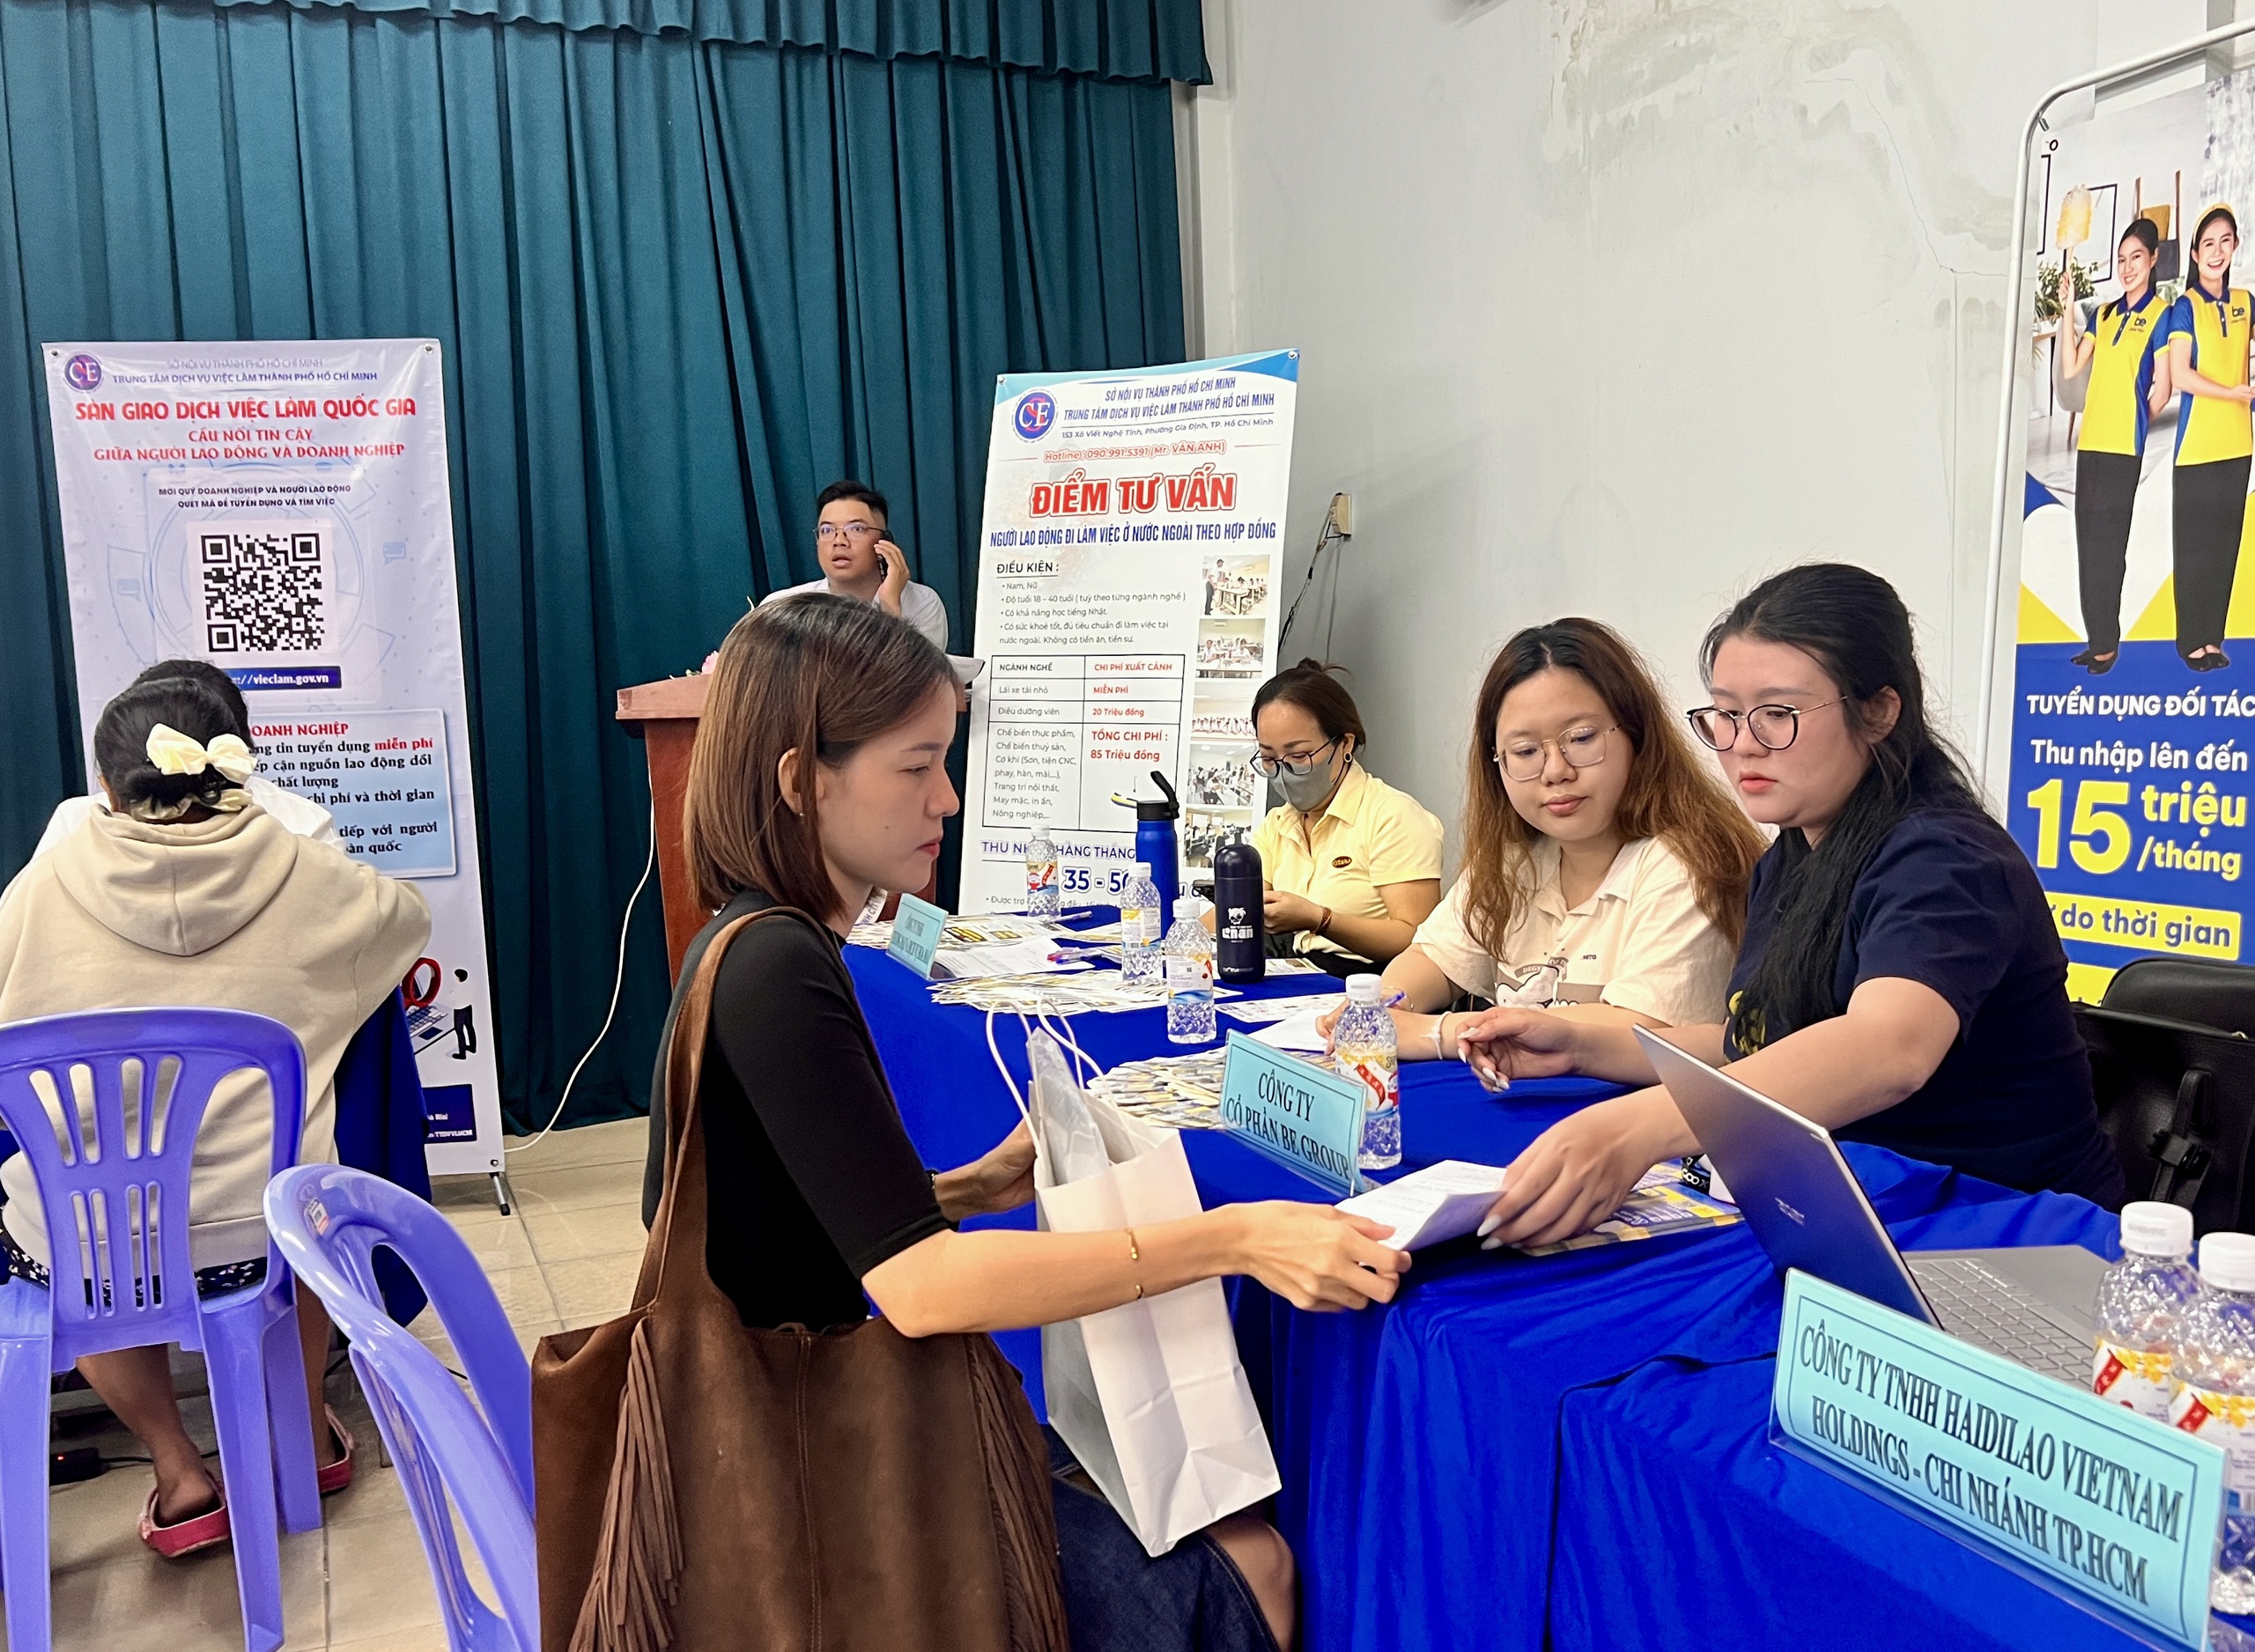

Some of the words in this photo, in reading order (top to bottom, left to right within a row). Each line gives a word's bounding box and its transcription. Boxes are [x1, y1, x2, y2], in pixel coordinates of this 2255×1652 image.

[351, 372, 377, 380] MINH
[76, 399, 115, 420] SÀN
[122, 402, 169, 420] GIAO
[176, 402, 220, 424] DỊCH
[227, 397, 269, 422] VIỆC
[275, 396, 316, 417] LÀM
[323, 393, 379, 419] QUỐC
[386, 398, 416, 416] GIA
[1045, 449, 1079, 461] Hotline
[1031, 469, 1109, 515] ĐIỂM
[1118, 476, 1161, 512] TƯ
[1166, 465, 1235, 510] VẤN
[990, 529, 1017, 547] NGƯỜI
[1019, 530, 1036, 546] LAO
[1038, 527, 1062, 548] ĐỘNG
[1065, 528, 1075, 544] ĐI
[1076, 525, 1097, 543] LÀM
[1099, 523, 1120, 546] VIỆC
[1122, 521, 1130, 542] Ở
[1132, 522, 1159, 542] NƯỚC
[1161, 521, 1193, 541] NGOÀI
[1196, 523, 1221, 540] THEO
[1224, 521, 1245, 542] HỢP
[1247, 517, 1275, 539] ĐỒNG
[996, 560, 1023, 573] ĐIỀU
[1026, 559, 1053, 572] KIỆN
[1030, 661, 1052, 671] NGHỀ
[1125, 661, 1145, 670] XUẤT
[1093, 683, 1113, 694] MIỄN
[2027, 685, 2096, 715] TUYỂN
[2098, 696, 2161, 721] DỤNG
[2164, 686, 2207, 717] ĐỐI
[2212, 690, 2255, 718] TÁC
[1124, 707, 1144, 717] đồng
[251, 725, 292, 736] OANH
[297, 721, 348, 737] NGHIỆP
[1091, 727, 1120, 740] TỔNG
[1123, 731, 1141, 741] CHI
[1143, 729, 1162, 741] PHÍ
[276, 743, 292, 753] tin
[298, 741, 333, 755] tuyển
[337, 741, 370, 754] dụng
[374, 738, 407, 750] miễn
[412, 738, 432, 750] phí
[273, 760, 295, 772] cận
[344, 757, 365, 769] lao
[370, 756, 405, 770] động
[1091, 749, 1102, 759] 85
[1105, 749, 1130, 759] Triệu
[1133, 749, 1159, 762] đồng
[2030, 740, 2074, 765] Thu
[2080, 741, 2143, 773] nhập
[2149, 741, 2189, 770] lên
[2195, 740, 2248, 771] đến
[301, 776, 338, 789] lượng
[329, 792, 351, 805] phí
[354, 792, 369, 802] và
[374, 789, 402, 801] thời
[406, 788, 434, 802] gian
[339, 824, 365, 838] tiếp
[372, 823, 392, 835] với
[400, 821, 437, 836] người
[2028, 778, 2132, 874] 15
[2141, 781, 2247, 837] triệu
[368, 840, 402, 854] quốc
[982, 842, 1009, 853] THU
[1094, 844, 1135, 859] THÁNG
[2136, 836, 2242, 881] /tháng
[1064, 869, 1090, 890] 35
[2060, 903, 2094, 929] do
[2102, 908, 2157, 938] thời
[2164, 912, 2230, 948] gian
[1258, 1068, 1295, 1113] CÔNG
[1296, 1088, 1315, 1123] TY
[1225, 1093, 1243, 1128] CỔ
[1246, 1106, 1280, 1147] PHẦN
[1281, 1125, 1300, 1157] BE
[1300, 1134, 1351, 1181] GROUP
[1800, 1318, 1852, 1386] CÔNG
[1856, 1350, 1883, 1399] TY
[1885, 1365, 1942, 1427] TNHH
[1942, 1394, 2056, 1482] HAIDILAO
[2062, 1439, 2185, 1543] VIETNAM
[1811, 1394, 1910, 1483] HOLDINGS
[1924, 1452, 1965, 1509] CHI
[1967, 1470, 2050, 1557] NHÁNH
[2052, 1514, 2150, 1606] TP.HCM
